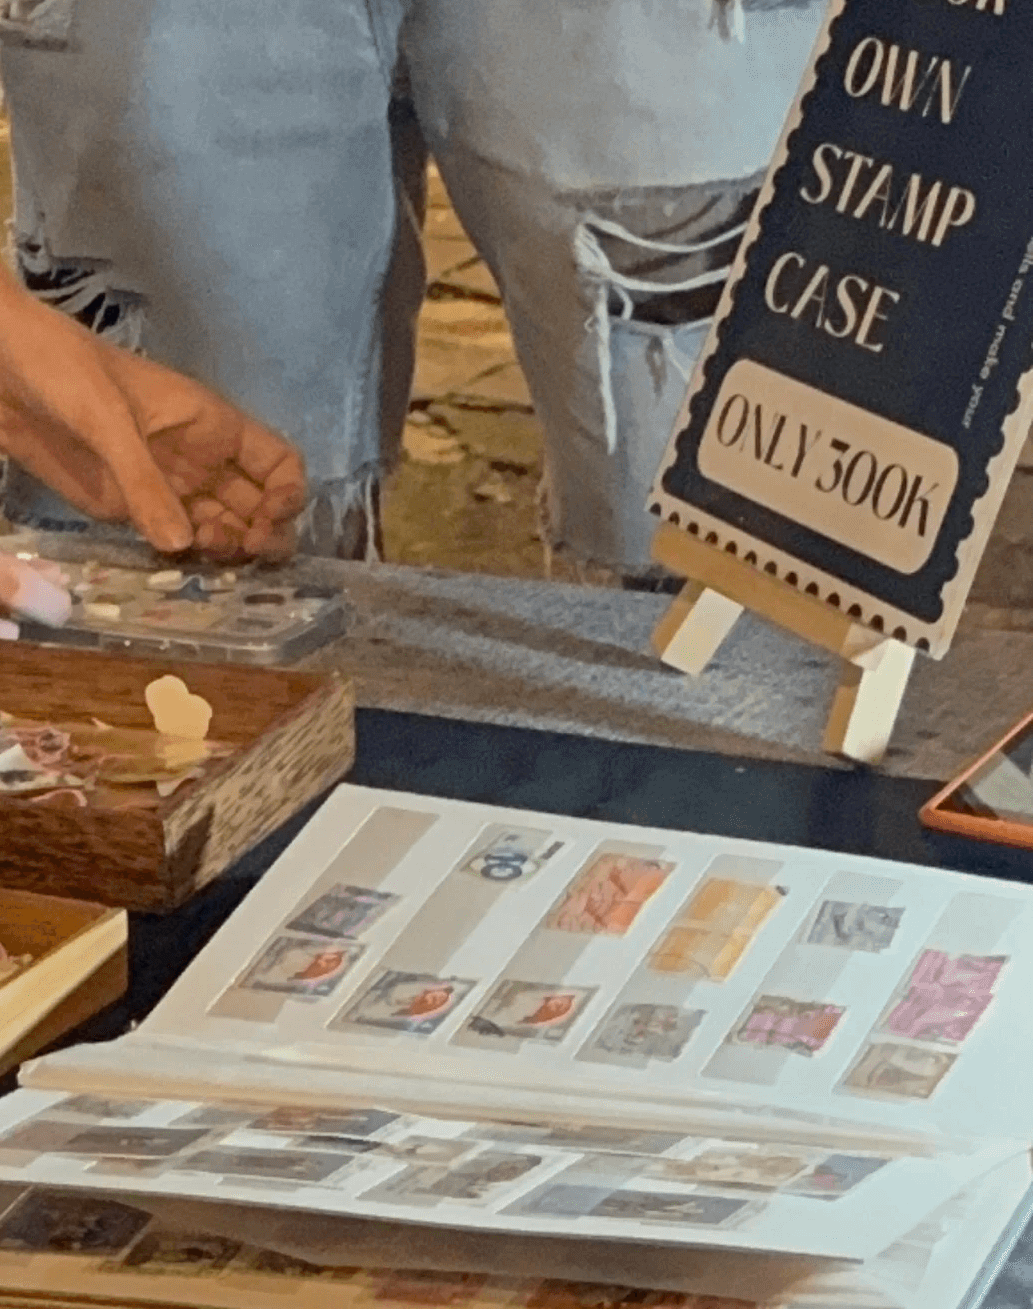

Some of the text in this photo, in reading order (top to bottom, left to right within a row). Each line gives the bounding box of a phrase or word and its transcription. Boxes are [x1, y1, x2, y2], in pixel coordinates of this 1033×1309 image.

[844, 37, 972, 125] OWN
[800, 143, 976, 247] STAMP
[765, 252, 900, 352] CASE
[1002, 278, 1024, 322] and
[979, 324, 1007, 380] make
[962, 383, 984, 429] your
[716, 393, 940, 538] ONLY 300K
